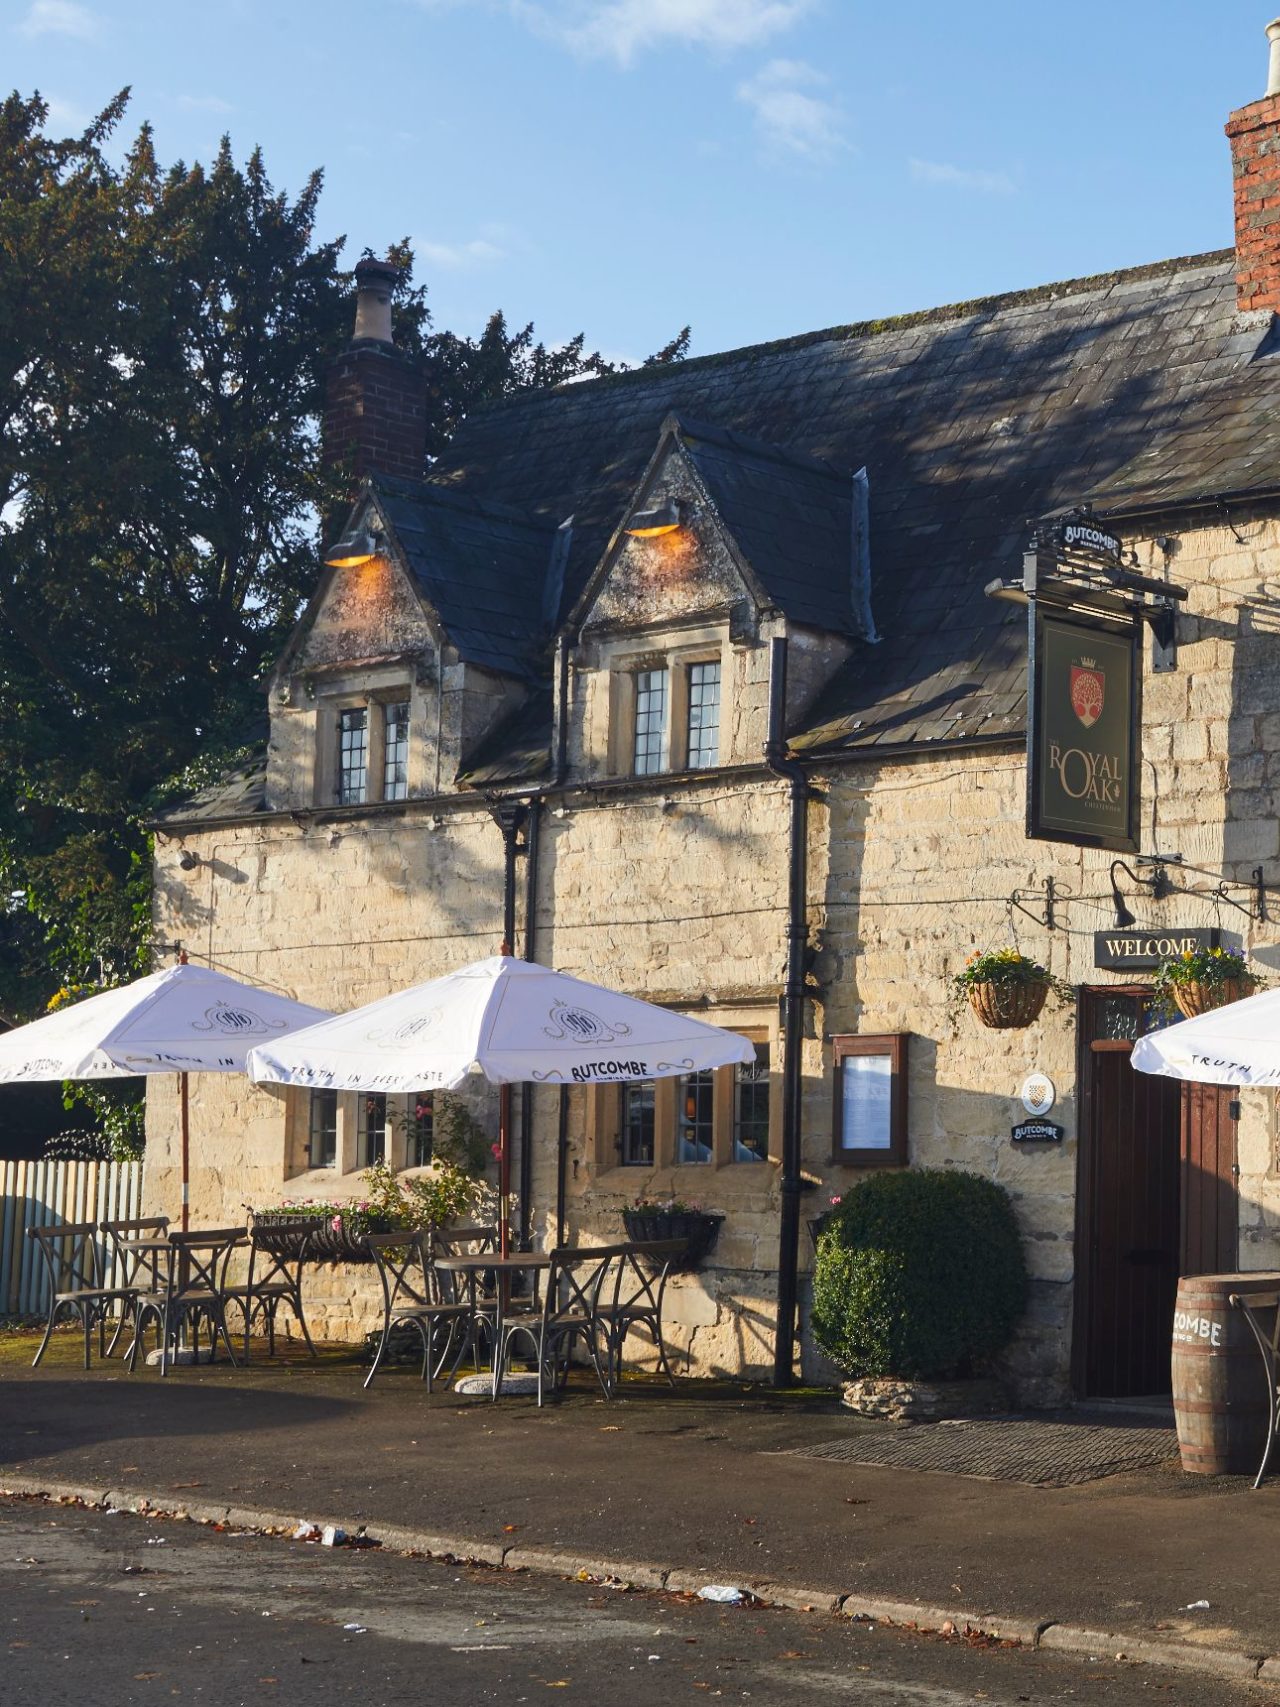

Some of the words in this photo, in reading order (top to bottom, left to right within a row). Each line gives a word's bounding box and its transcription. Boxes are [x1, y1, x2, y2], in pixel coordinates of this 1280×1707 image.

[1065, 526, 1119, 558] BUTCOMBE
[1048, 744, 1123, 798] ROYAL
[1106, 938, 1197, 957] WELCOME
[218, 1058, 234, 1066] IN
[571, 1060, 654, 1083] BUTCOMBE
[1192, 1054, 1251, 1073] TRUTH
[348, 1074, 361, 1083] IN
[1014, 1125, 1058, 1140] BUTCOMBE
